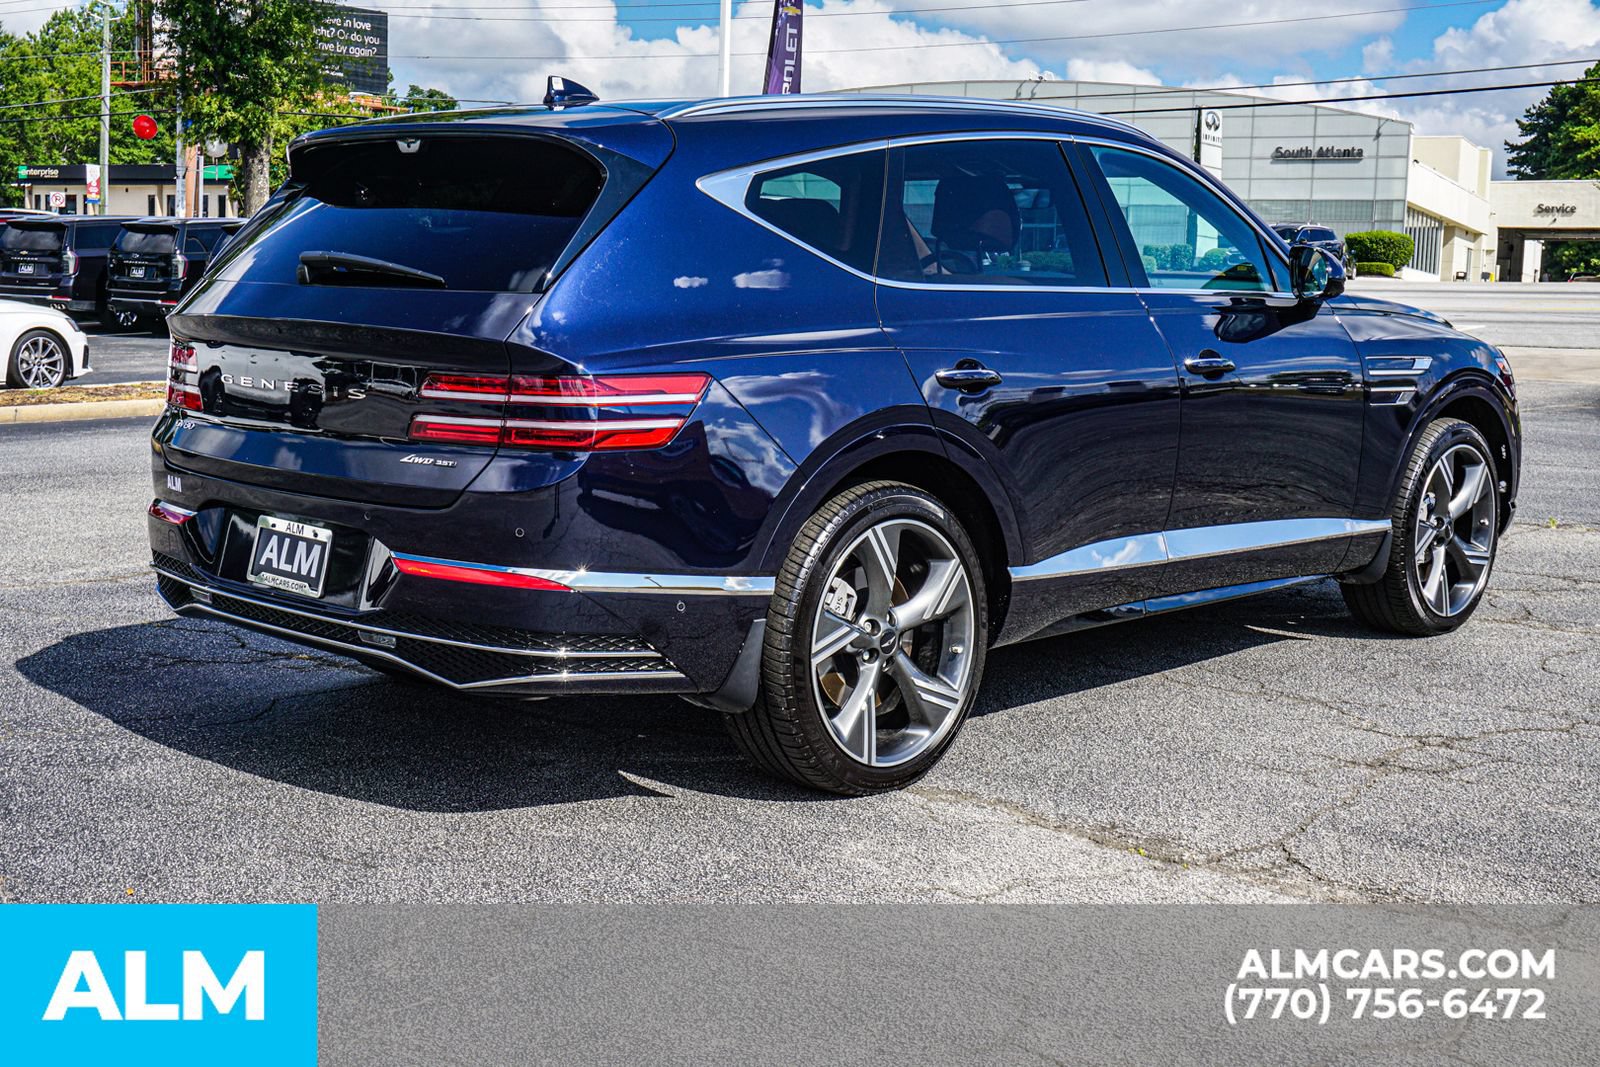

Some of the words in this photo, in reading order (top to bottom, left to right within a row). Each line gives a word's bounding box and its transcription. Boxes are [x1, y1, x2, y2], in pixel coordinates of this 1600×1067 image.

[343, 17, 352, 28] in
[353, 18, 372, 30] love
[337, 29, 349, 40] Or
[350, 31, 362, 42] do
[364, 35, 380, 47] you
[336, 42, 348, 55] by
[349, 47, 377, 57] again?
[1274, 146, 1313, 158] South
[1316, 145, 1364, 158] Atlanta
[20, 167, 59, 177] enterprise
[1537, 203, 1577, 214] Service
[220, 373, 367, 400] GENESIS
[167, 474, 182, 493] ALM
[285, 522, 305, 536] ALM
[259, 534, 322, 578] ALM
[264, 575, 304, 591] ALMCARS.COM
